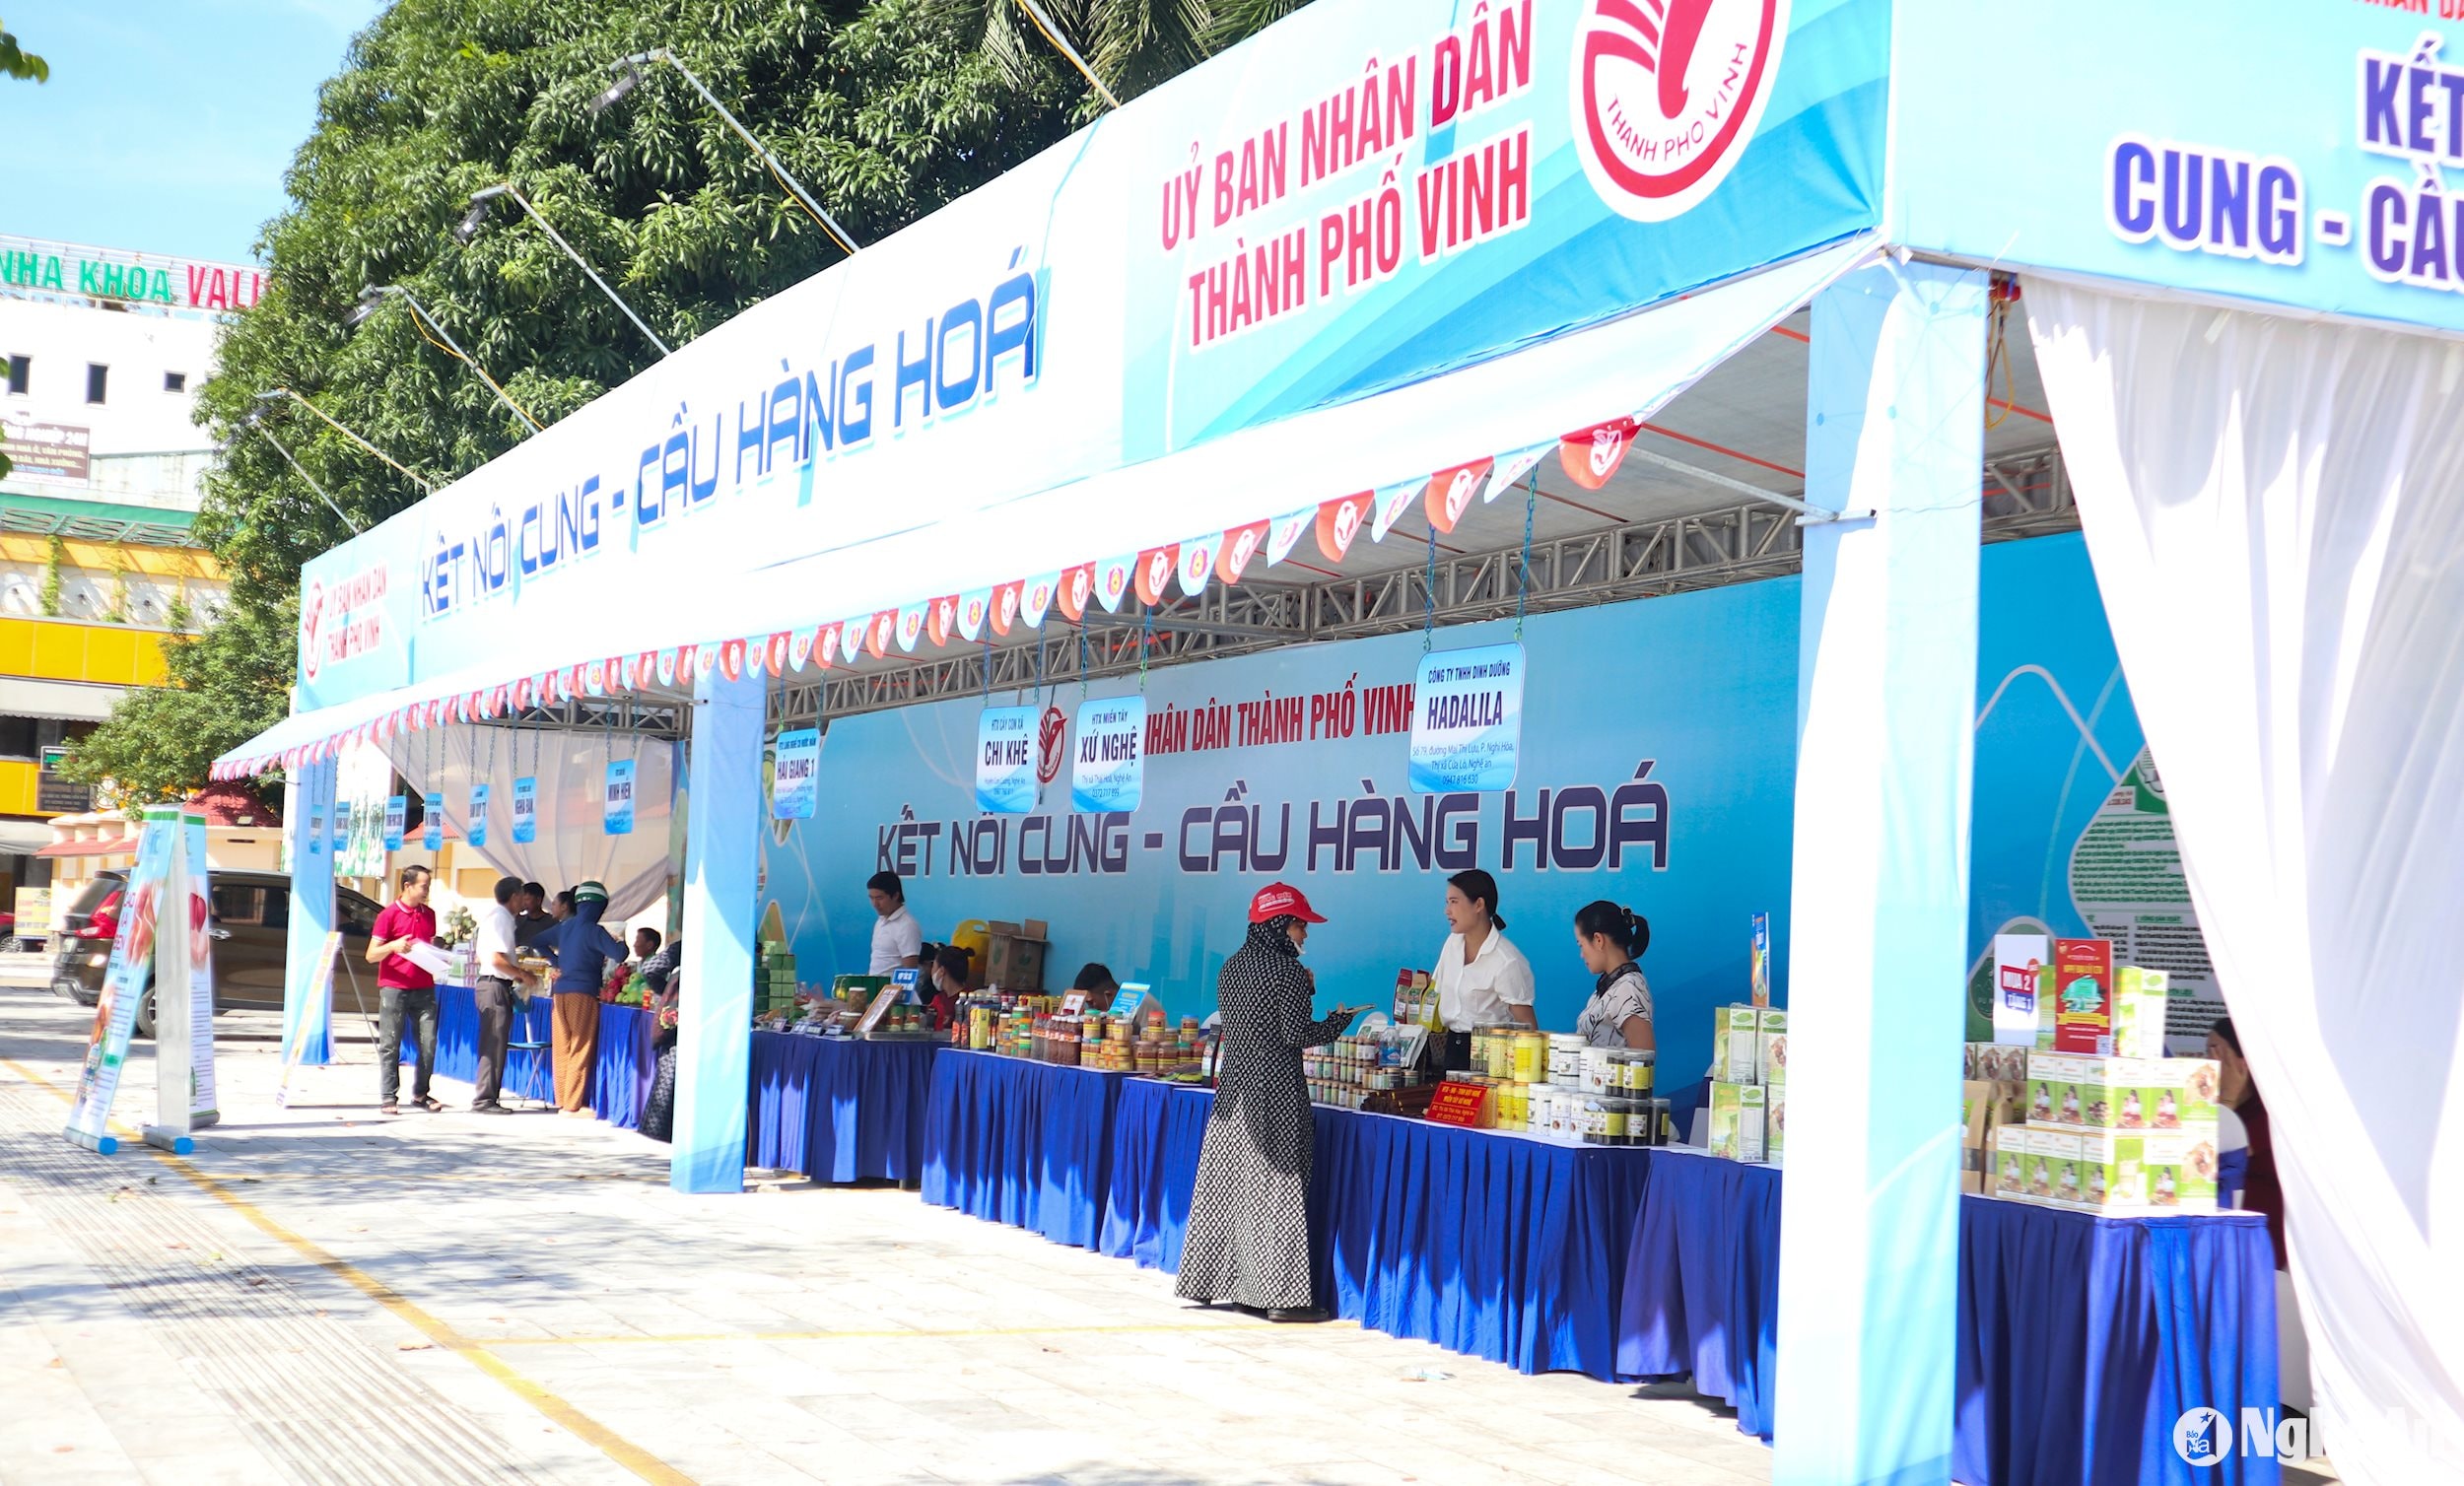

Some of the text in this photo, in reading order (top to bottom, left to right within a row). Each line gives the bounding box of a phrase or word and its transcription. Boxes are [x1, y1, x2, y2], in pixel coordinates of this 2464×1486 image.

[1705, 42, 1747, 120] VINH
[2365, 39, 2464, 159] KẾT
[1213, 120, 1288, 229] BAN
[1300, 56, 1417, 188] NHÂN
[1431, 0, 1533, 128] DÂN
[2114, 142, 2297, 256] CUNG
[1189, 129, 1529, 347] THÀNH PHỐ VINH
[79, 259, 171, 304] KHOA
[422, 530, 464, 618] KẾT
[472, 502, 512, 598] NỐI
[520, 475, 599, 575] CUNG
[638, 400, 722, 525] CẦU
[735, 343, 875, 486] HÀNG
[893, 244, 1036, 429] HOÁ
[1446, 668, 1454, 682] TY
[1092, 713, 1102, 725] HTX
[1192, 697, 1232, 751] DÂN
[1238, 690, 1304, 747] THÀNH
[1309, 672, 1359, 741] PHỐ
[1426, 691, 1503, 731] HADALILA
[777, 755, 815, 780] HẢI GIANG 1
[986, 740, 1002, 767] CHI
[1006, 733, 1029, 766] KHÊ
[1080, 729, 1099, 764] XỨ
[1101, 725, 1137, 768] NGHỆ
[876, 804, 940, 876] KẾT
[1018, 811, 1130, 875] CUNG
[1179, 778, 1291, 873] CẦU
[1306, 778, 1479, 872] HÀNG
[1501, 760, 1669, 871] HOÁ
[2023, 975, 2031, 991] 2
